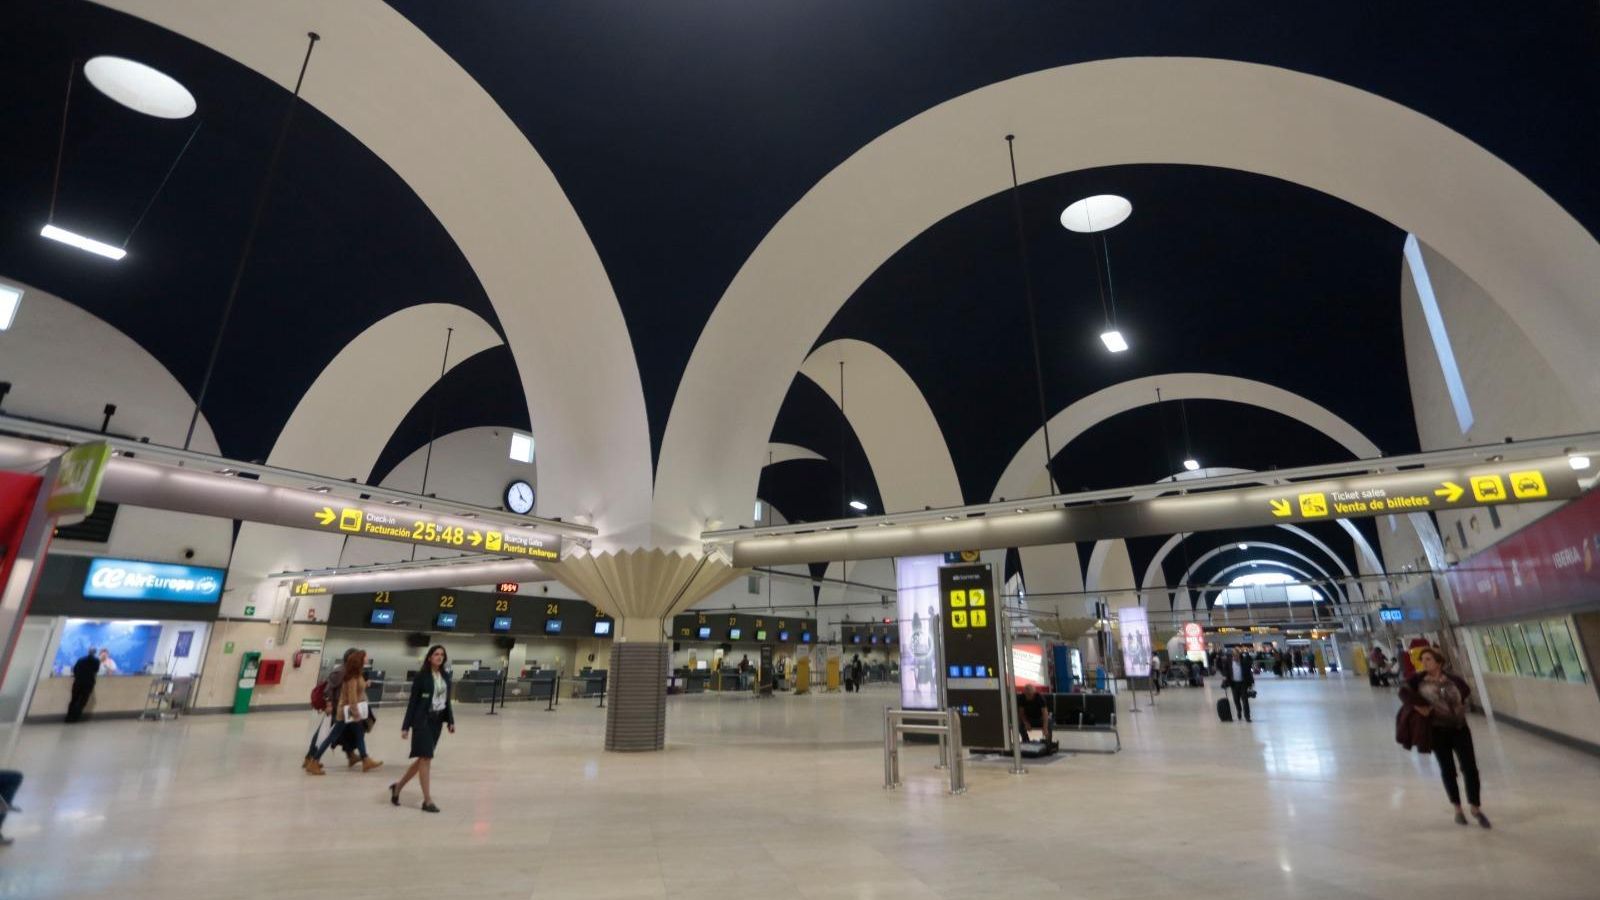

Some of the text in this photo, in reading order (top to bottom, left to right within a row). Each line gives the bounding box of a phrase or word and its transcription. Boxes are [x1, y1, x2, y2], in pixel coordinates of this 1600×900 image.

[1331, 488, 1386, 501] Ticket sales
[1334, 496, 1430, 513] Venta de billetes
[366, 512, 396, 524] Check-in
[365, 522, 411, 538] Facturación
[412, 520, 436, 541] 25
[441, 525, 464, 545] 48
[503, 542, 527, 554] Puertas
[375, 591, 391, 603] 21
[440, 595, 455, 608] 22
[496, 600, 508, 612] 23
[546, 604, 558, 615] 24
